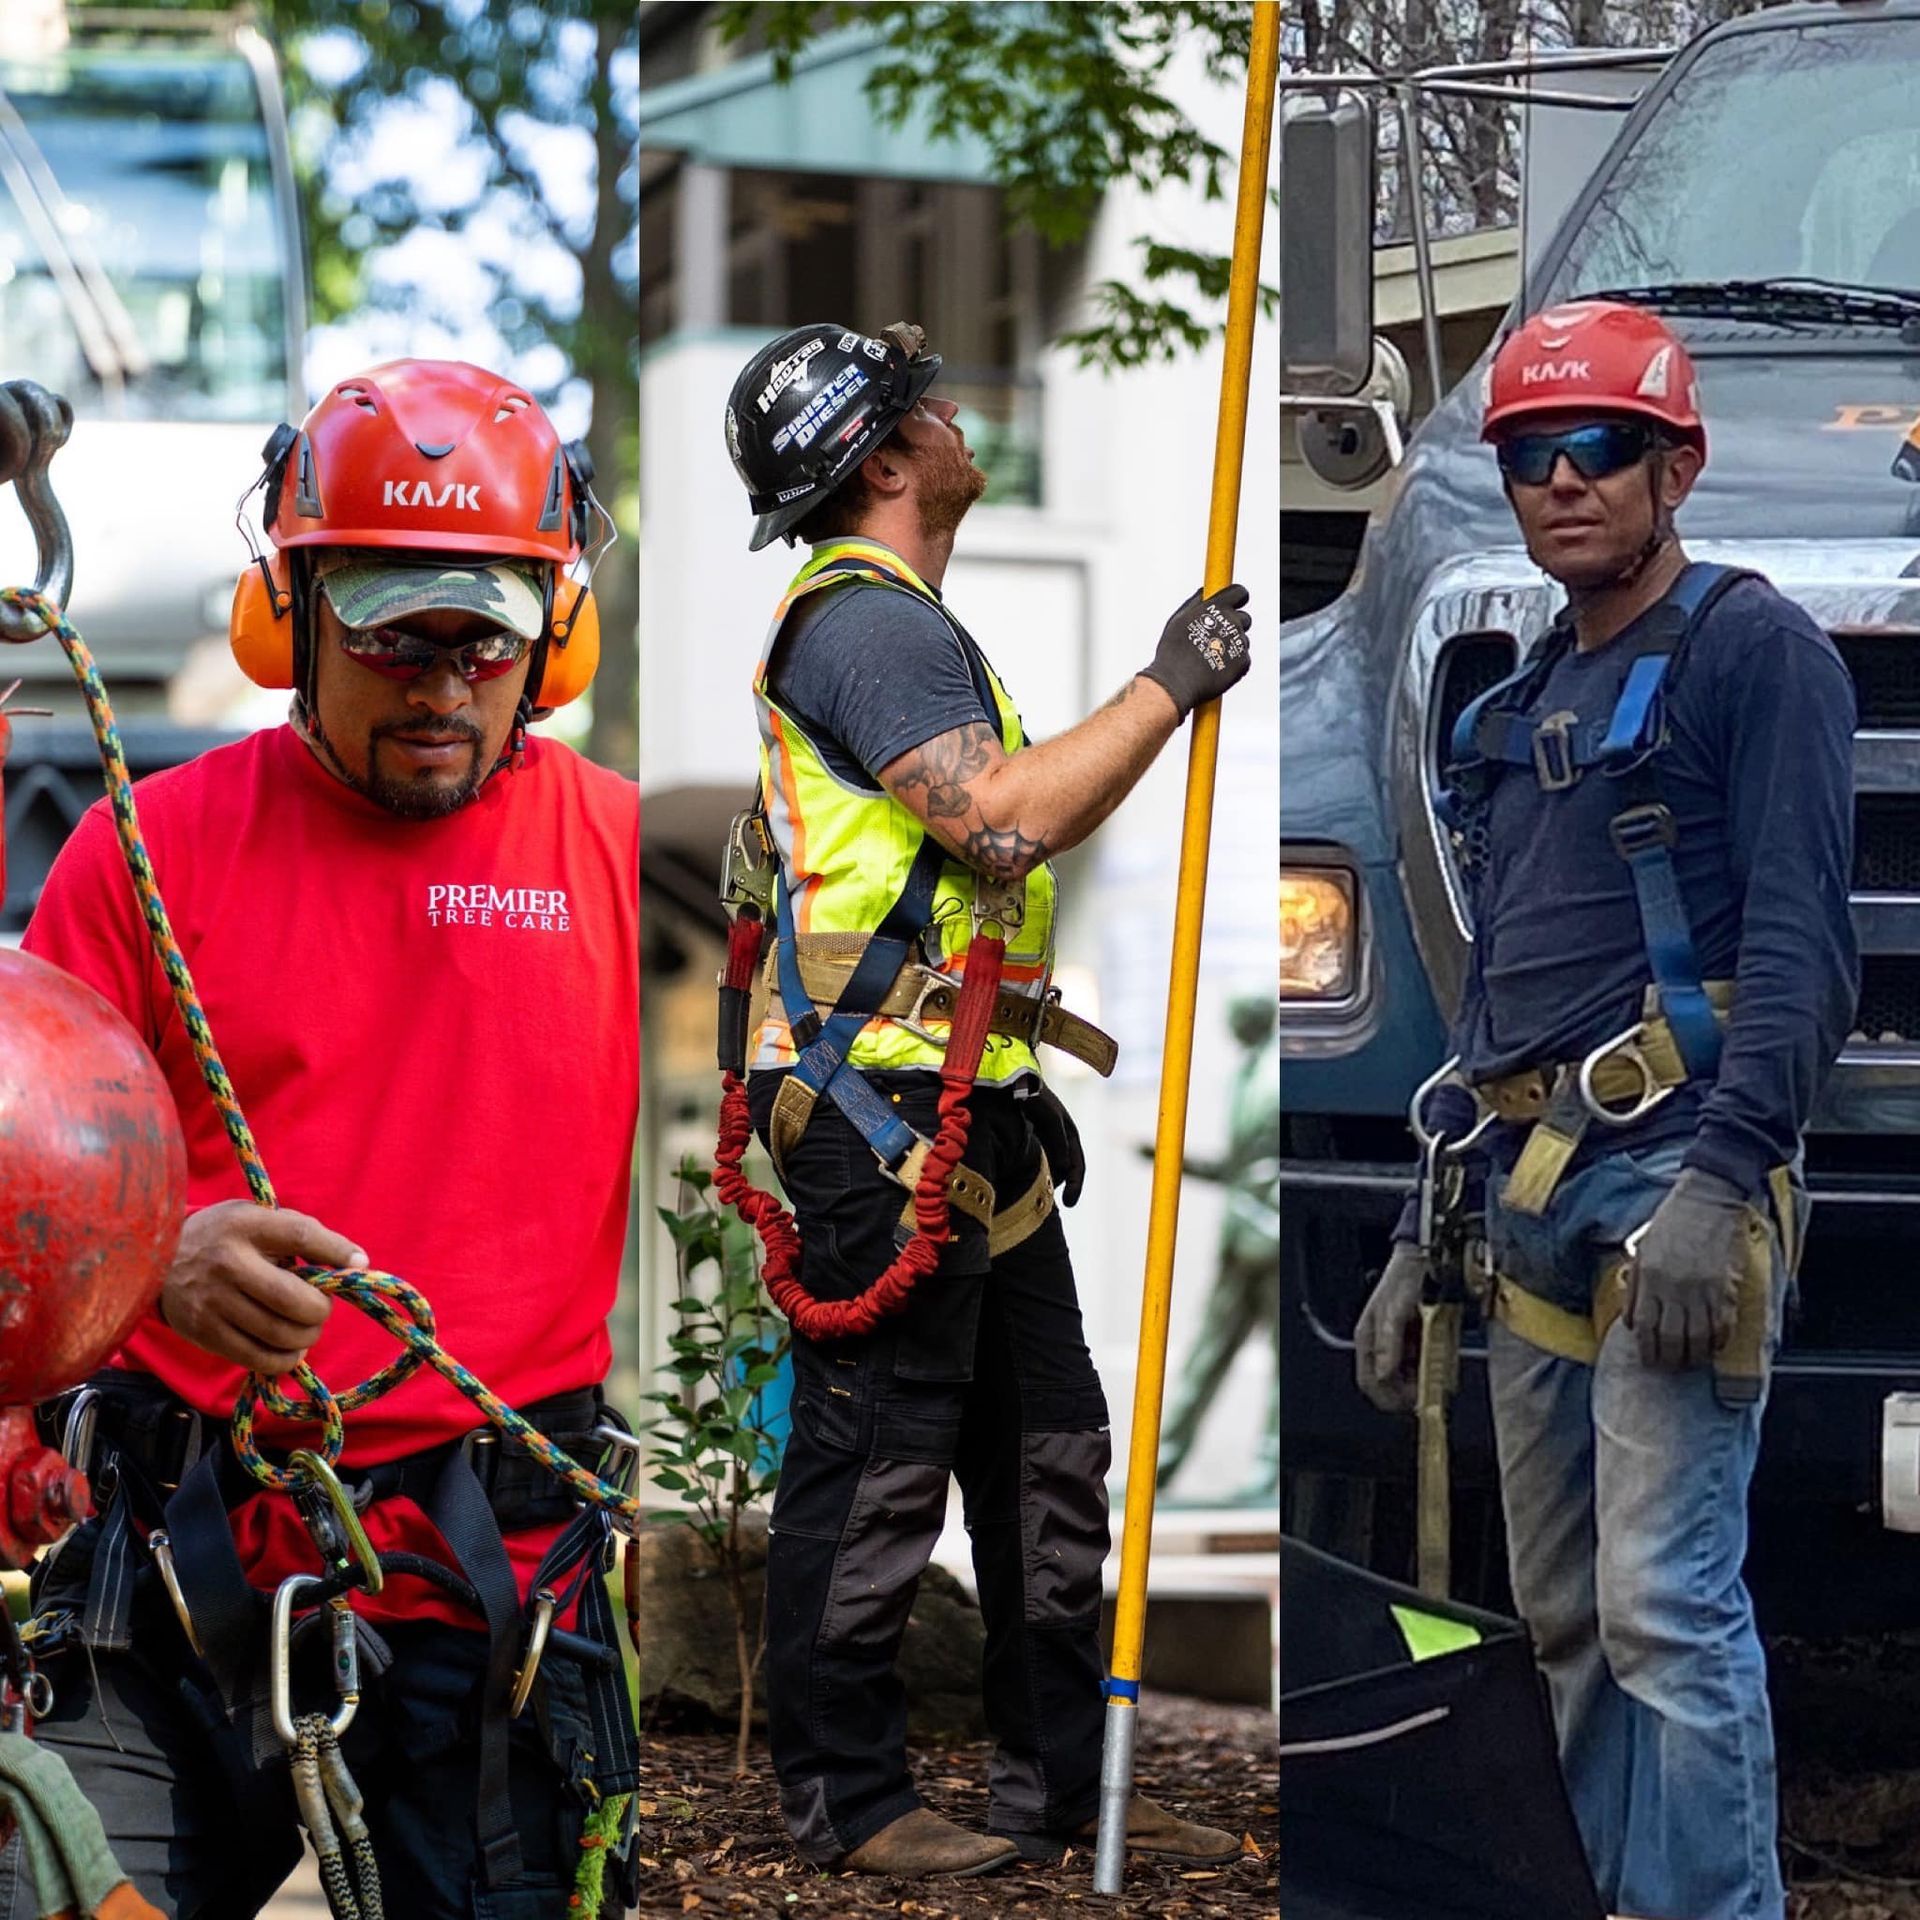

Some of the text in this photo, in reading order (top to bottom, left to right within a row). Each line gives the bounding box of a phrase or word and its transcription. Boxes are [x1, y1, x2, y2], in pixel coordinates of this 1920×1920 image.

[1522, 360, 1590, 385] KASK
[772, 363, 860, 454] SINISTER
[795, 371, 871, 449] DIESEL
[383, 481, 481, 511] KASK
[428, 884, 569, 915] PREMIER
[428, 909, 570, 931] TREE CARE
